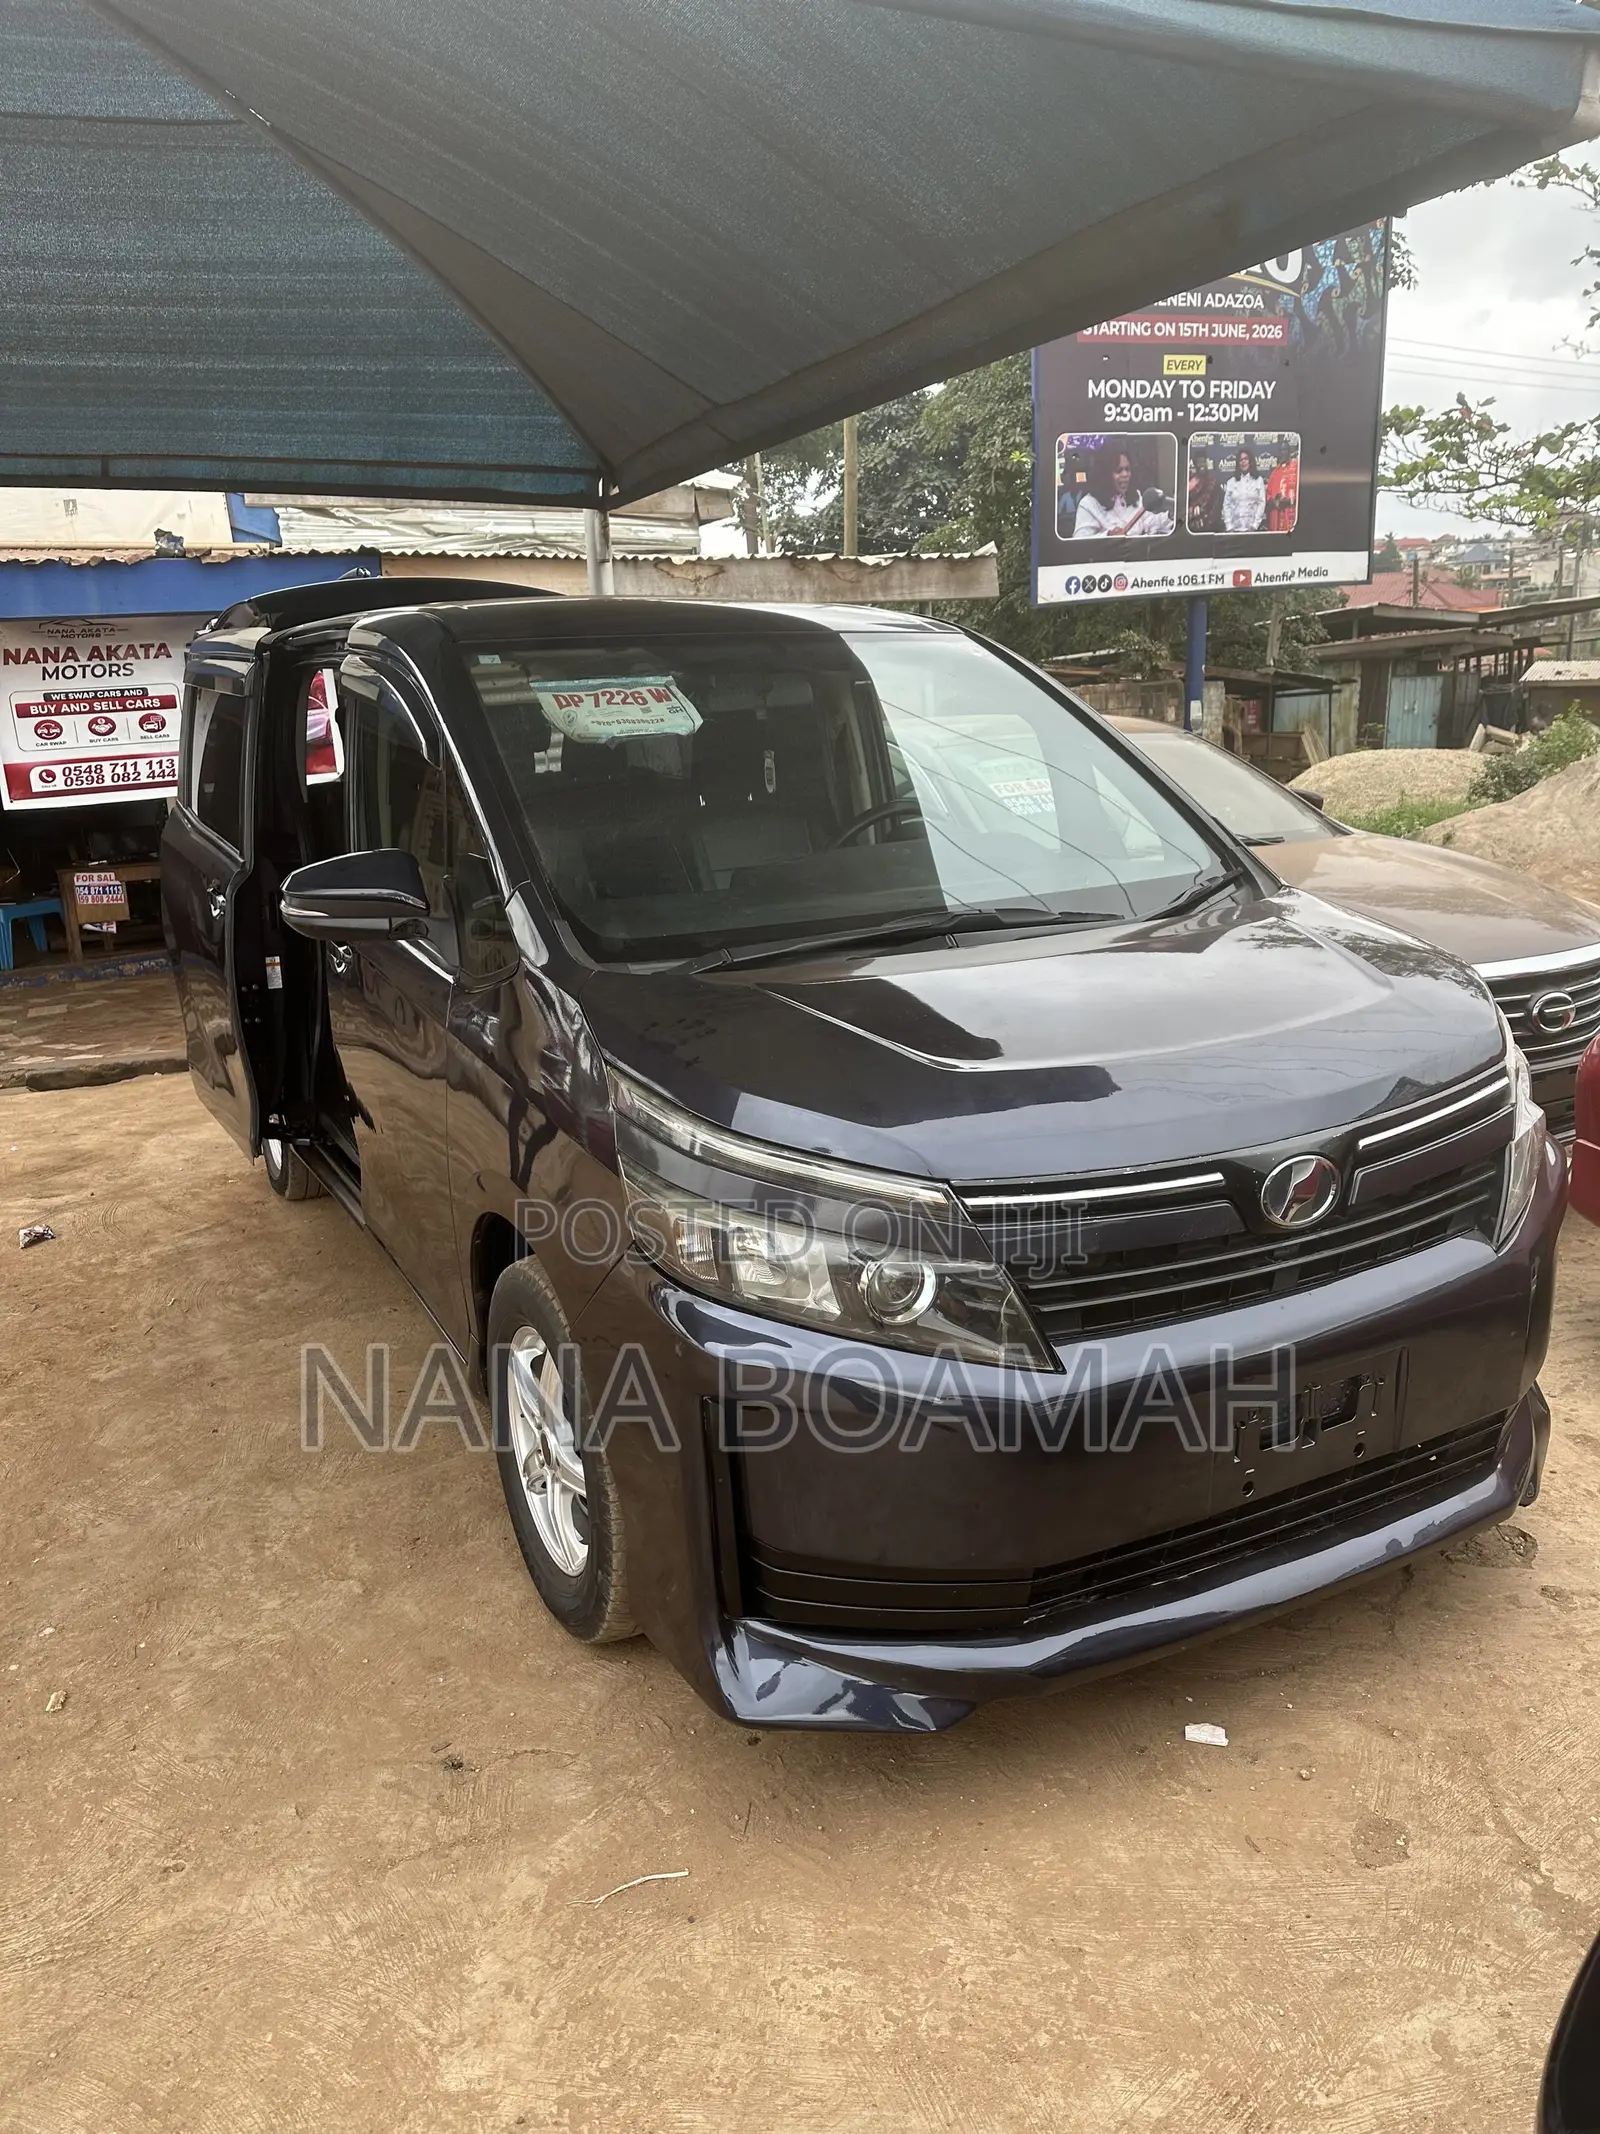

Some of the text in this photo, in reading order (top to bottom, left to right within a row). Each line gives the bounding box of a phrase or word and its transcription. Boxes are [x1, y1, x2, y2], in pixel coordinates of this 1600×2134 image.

[1204, 293, 1264, 309] ADAZOA
[1154, 321, 1176, 336] ON
[1178, 323, 1208, 338] 15TH
[1211, 323, 1250, 340] JUNE,
[1252, 324, 1283, 339] 2026
[1166, 359, 1202, 371] EVERY
[1088, 379, 1276, 400] MONDAY TO FRIDAY
[1103, 403, 1172, 422] 9:30am
[1187, 403, 1259, 422] 12:30PM
[1130, 573, 1225, 589] Ahenfie 106.1 FM
[1254, 566, 1329, 583] Ahenfie Media
[3, 643, 173, 666] NANA AKATA
[42, 662, 135, 681] MOTORS
[51, 689, 143, 701] WE SWAP CARS AND
[552, 688, 673, 710] DP 7226 W
[30, 698, 161, 715] BUY AND SELL CARS
[62, 758, 175, 777] 0548 711 113
[64, 768, 177, 787] 0598 082 444
[90, 886, 103, 895] 871
[106, 886, 122, 895] 1113
